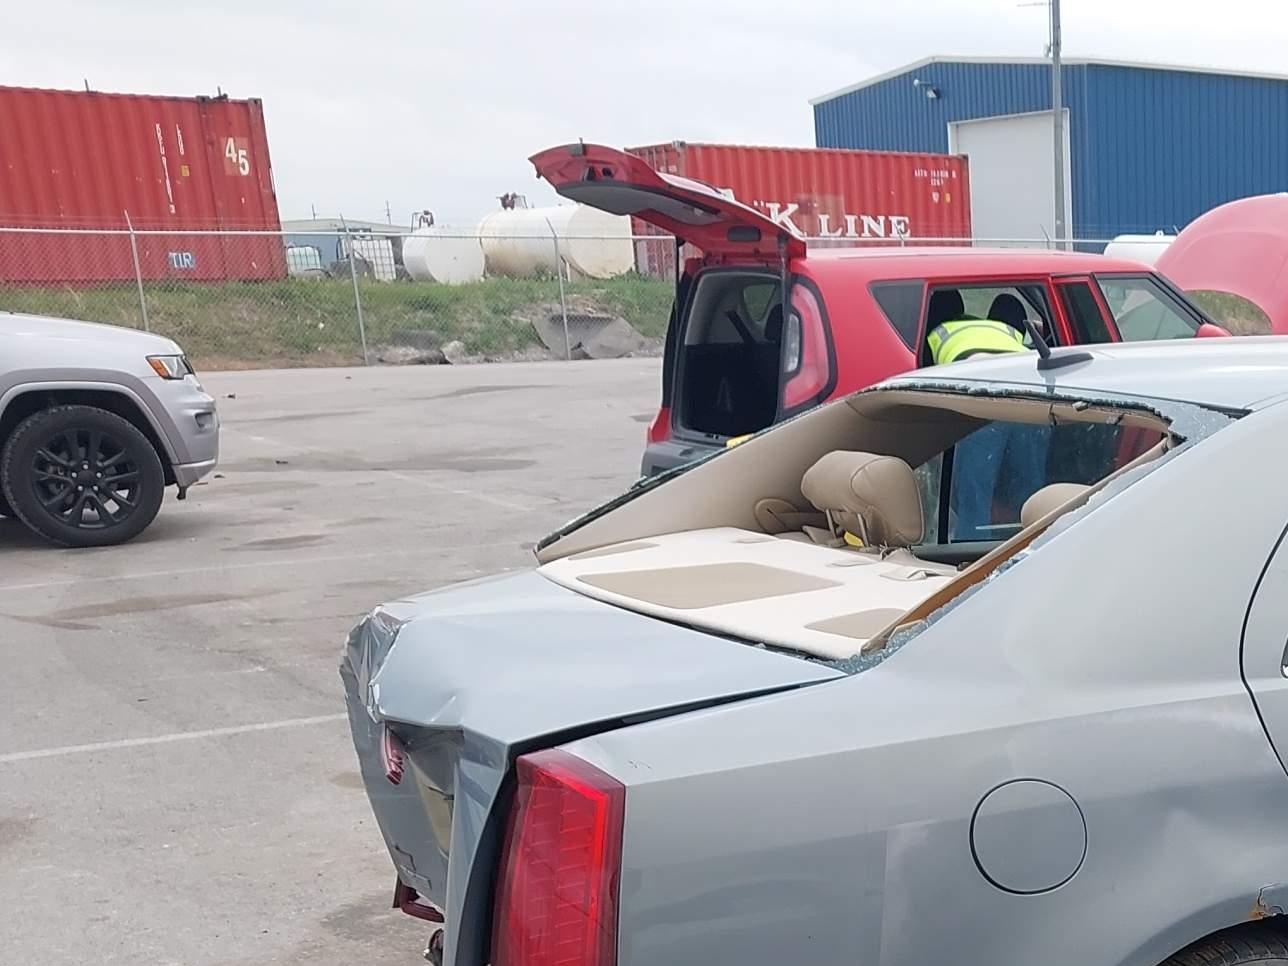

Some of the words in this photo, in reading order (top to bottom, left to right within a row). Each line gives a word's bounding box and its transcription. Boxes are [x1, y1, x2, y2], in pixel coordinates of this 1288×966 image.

[225, 137, 250, 176] 45
[818, 214, 912, 238] LINE
[168, 251, 193, 268] TIR
